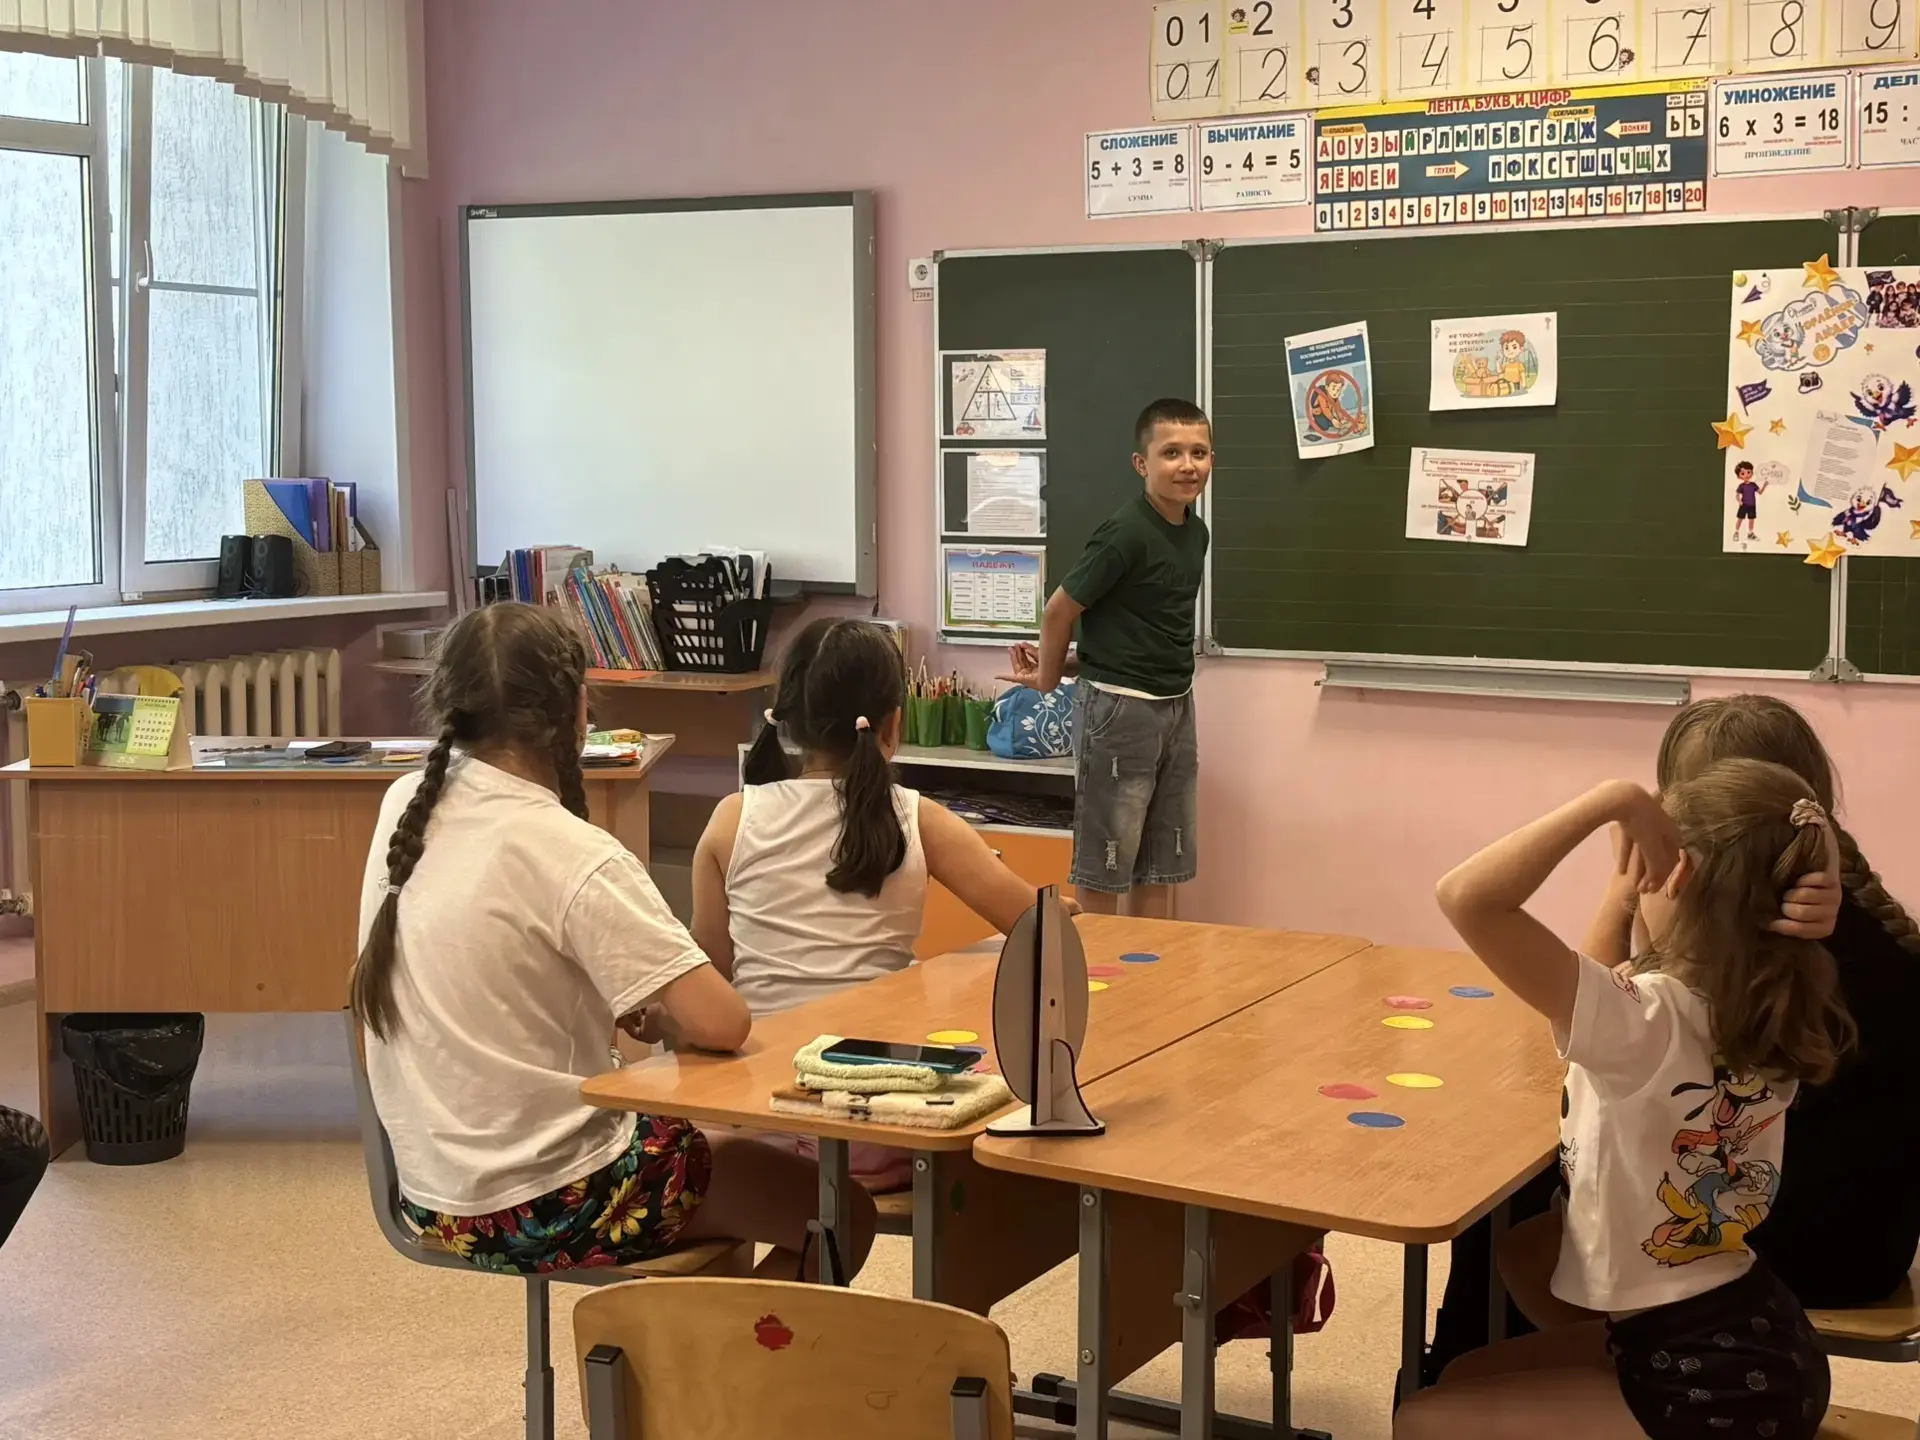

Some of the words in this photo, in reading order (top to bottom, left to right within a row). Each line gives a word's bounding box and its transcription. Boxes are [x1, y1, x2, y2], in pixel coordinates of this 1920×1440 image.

[1166, 16, 1183, 47] 0
[1199, 12, 1210, 44] 1
[1252, 1, 1274, 36] 2
[1332, 0, 1354, 29] 3
[1166, 63, 1189, 100] 0
[1205, 59, 1220, 98] 1
[1258, 48, 1287, 100] 2
[1338, 41, 1367, 93] 3
[1421, 33, 1449, 87] 4
[1502, 24, 1533, 79] 5
[1589, 16, 1621, 72] 6
[1682, 8, 1711, 66] 7
[1770, 0, 1804, 57] 8
[1865, 0, 1901, 50] 9
[1427, 99, 1470, 114] ЛЕНТА
[1475, 95, 1511, 110] БУКВ
[1516, 94, 1528, 105] И
[1530, 89, 1571, 106] ЦИФР
[1724, 83, 1836, 106] УМНОЖЕНИЕ
[1719, 115, 1730, 138] 6
[1773, 112, 1784, 134] 3
[1818, 108, 1839, 131] 18
[1863, 101, 1888, 125] 15
[1100, 132, 1178, 151] СЛОЖЕНИЕ
[1207, 123, 1296, 144] ВЫЧИТАНИЕ
[1091, 160, 1101, 180] 5
[1132, 157, 1142, 177] 3
[1174, 154, 1184, 174] 8
[1203, 155, 1214, 175] 9
[1242, 152, 1254, 172] 4
[1289, 149, 1300, 169] 5
[1319, 210, 1328, 224] 0
[1337, 209, 1344, 223] 1
[1354, 207, 1362, 221] 2
[1371, 206, 1380, 220] 3
[1388, 205, 1397, 220] 4
[1406, 204, 1415, 218] 5
[1424, 203, 1432, 217] 6
[1442, 202, 1450, 217] 7
[1460, 201, 1468, 216] 8
[1478, 200, 1486, 214] 9
[1493, 199, 1507, 213] 10
[1513, 197, 1527, 212] 11
[1532, 196, 1546, 211] 12
[1550, 195, 1565, 210] 13
[1570, 194, 1584, 209] 14
[1589, 193, 1603, 208] 15
[1608, 192, 1622, 206] 16
[1628, 191, 1643, 205] 17
[1647, 189, 1661, 204] 18
[1667, 188, 1682, 203] 19
[1686, 187, 1701, 203] 20
